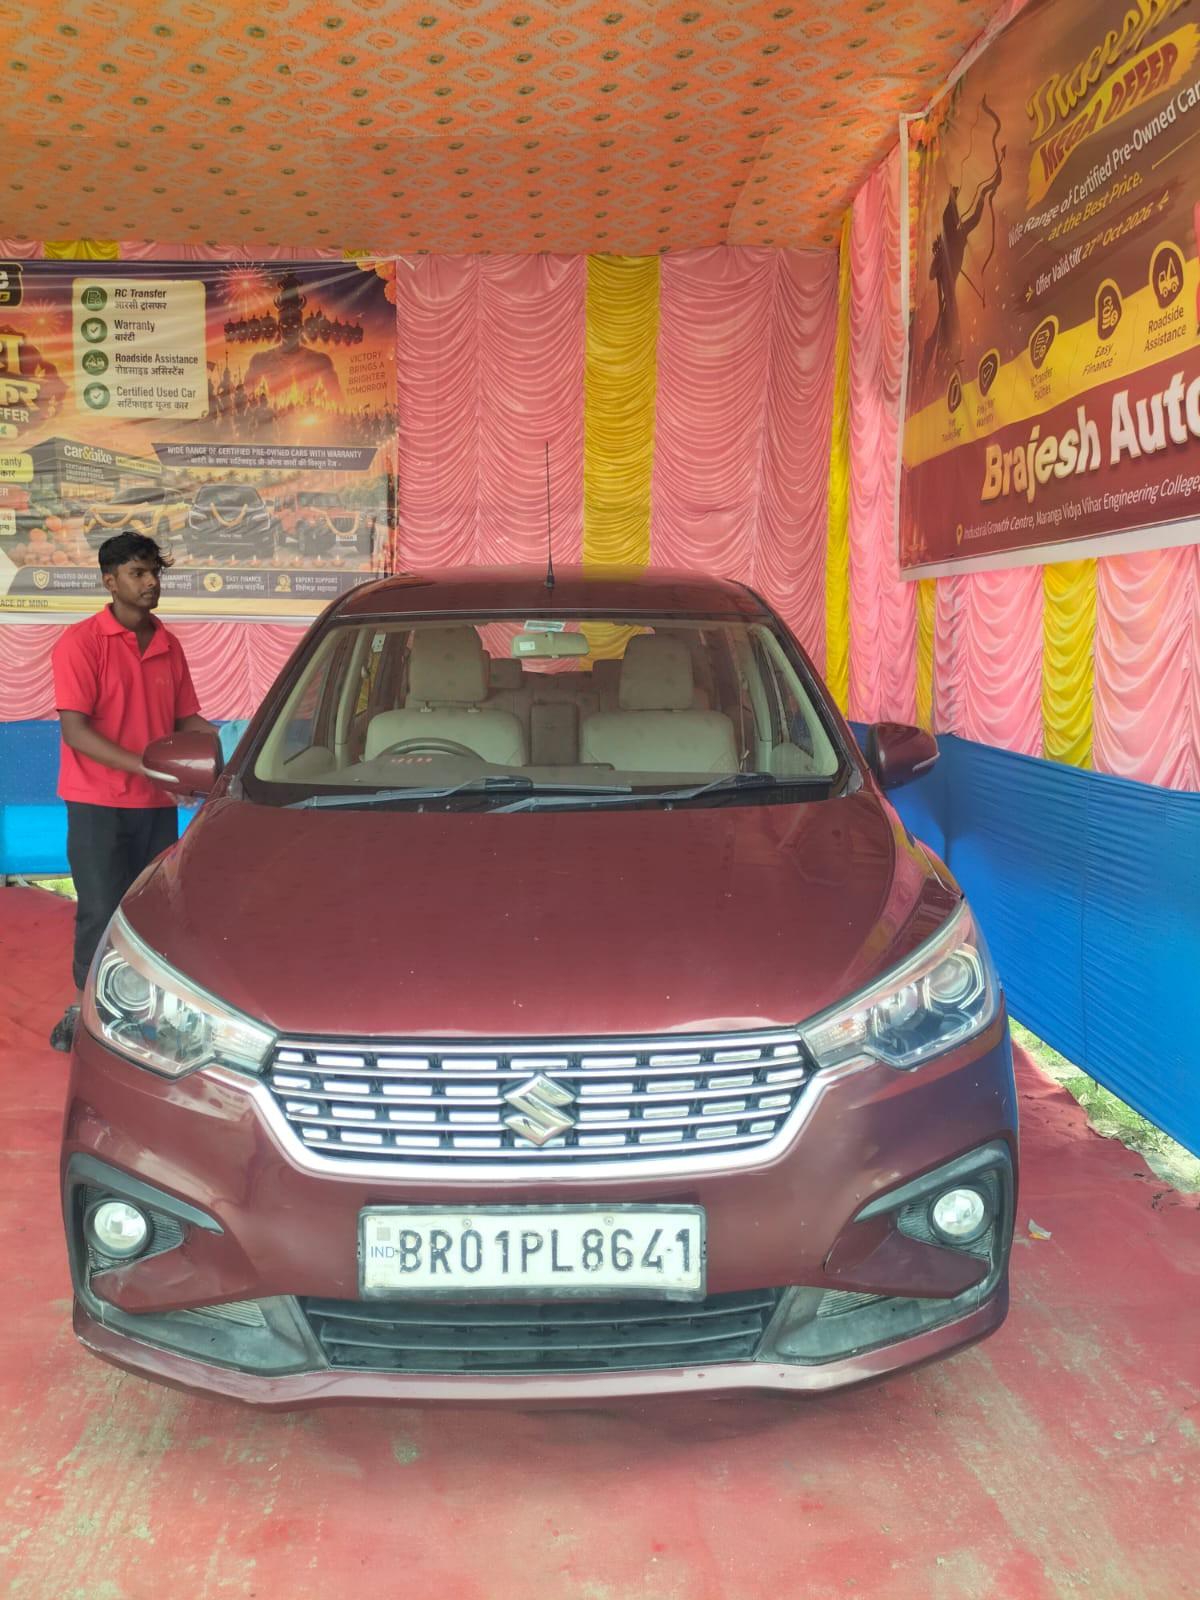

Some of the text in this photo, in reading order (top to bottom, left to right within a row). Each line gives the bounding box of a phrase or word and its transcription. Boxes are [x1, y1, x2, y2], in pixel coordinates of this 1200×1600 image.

[1039, 42, 1178, 181] MEGA OFFER
[1023, 204, 1060, 233] Range
[1060, 189, 1073, 213] of
[1073, 153, 1112, 205] Certified
[1112, 98, 1177, 171] Pre-Owned
[1048, 171, 1143, 241] at the Best Price.
[1035, 272, 1052, 296] Offer
[1051, 256, 1070, 283] Valid
[1069, 245, 1083, 268] till
[1102, 222, 1124, 247] Oct
[1121, 201, 1154, 234] 2026
[114, 288, 167, 298] RC Transfer
[114, 320, 155, 332] Warranty
[1148, 305, 1184, 334] Roadside
[1143, 324, 1187, 352] Assistance
[115, 353, 199, 365] Roadside Assistance
[350, 351, 382, 363] VICTORY
[1094, 343, 1114, 358] Easy
[349, 361, 385, 375] BRINGS A
[1082, 357, 1114, 377] Finance
[348, 372, 385, 384] BRIGHTER
[116, 386, 196, 398] Certified Used Car
[347, 382, 387, 395] TOMORROW
[64, 445, 112, 464] car&bike
[167, 446, 184, 455] WIDE
[218, 447, 250, 456] CERTIFIED
[252, 448, 289, 457] PRE-OWNED
[290, 449, 309, 457] CARS
[309, 449, 326, 457] WITH
[326, 449, 362, 458] WARRANTY
[981, 404, 1101, 504] Brajesh
[964, 521, 988, 540] Industrial
[987, 517, 1010, 535] Growth
[1010, 515, 1035, 531] Centre,
[1036, 508, 1063, 526] Maranga
[1062, 501, 1082, 521] Vidya
[1081, 496, 1102, 515] Vihar
[1103, 483, 1160, 512] Engineering
[16, 599, 25, 608] OF
[29, 599, 49, 608] MIND
[370, 1228, 691, 1274] IND BR01PL8641
